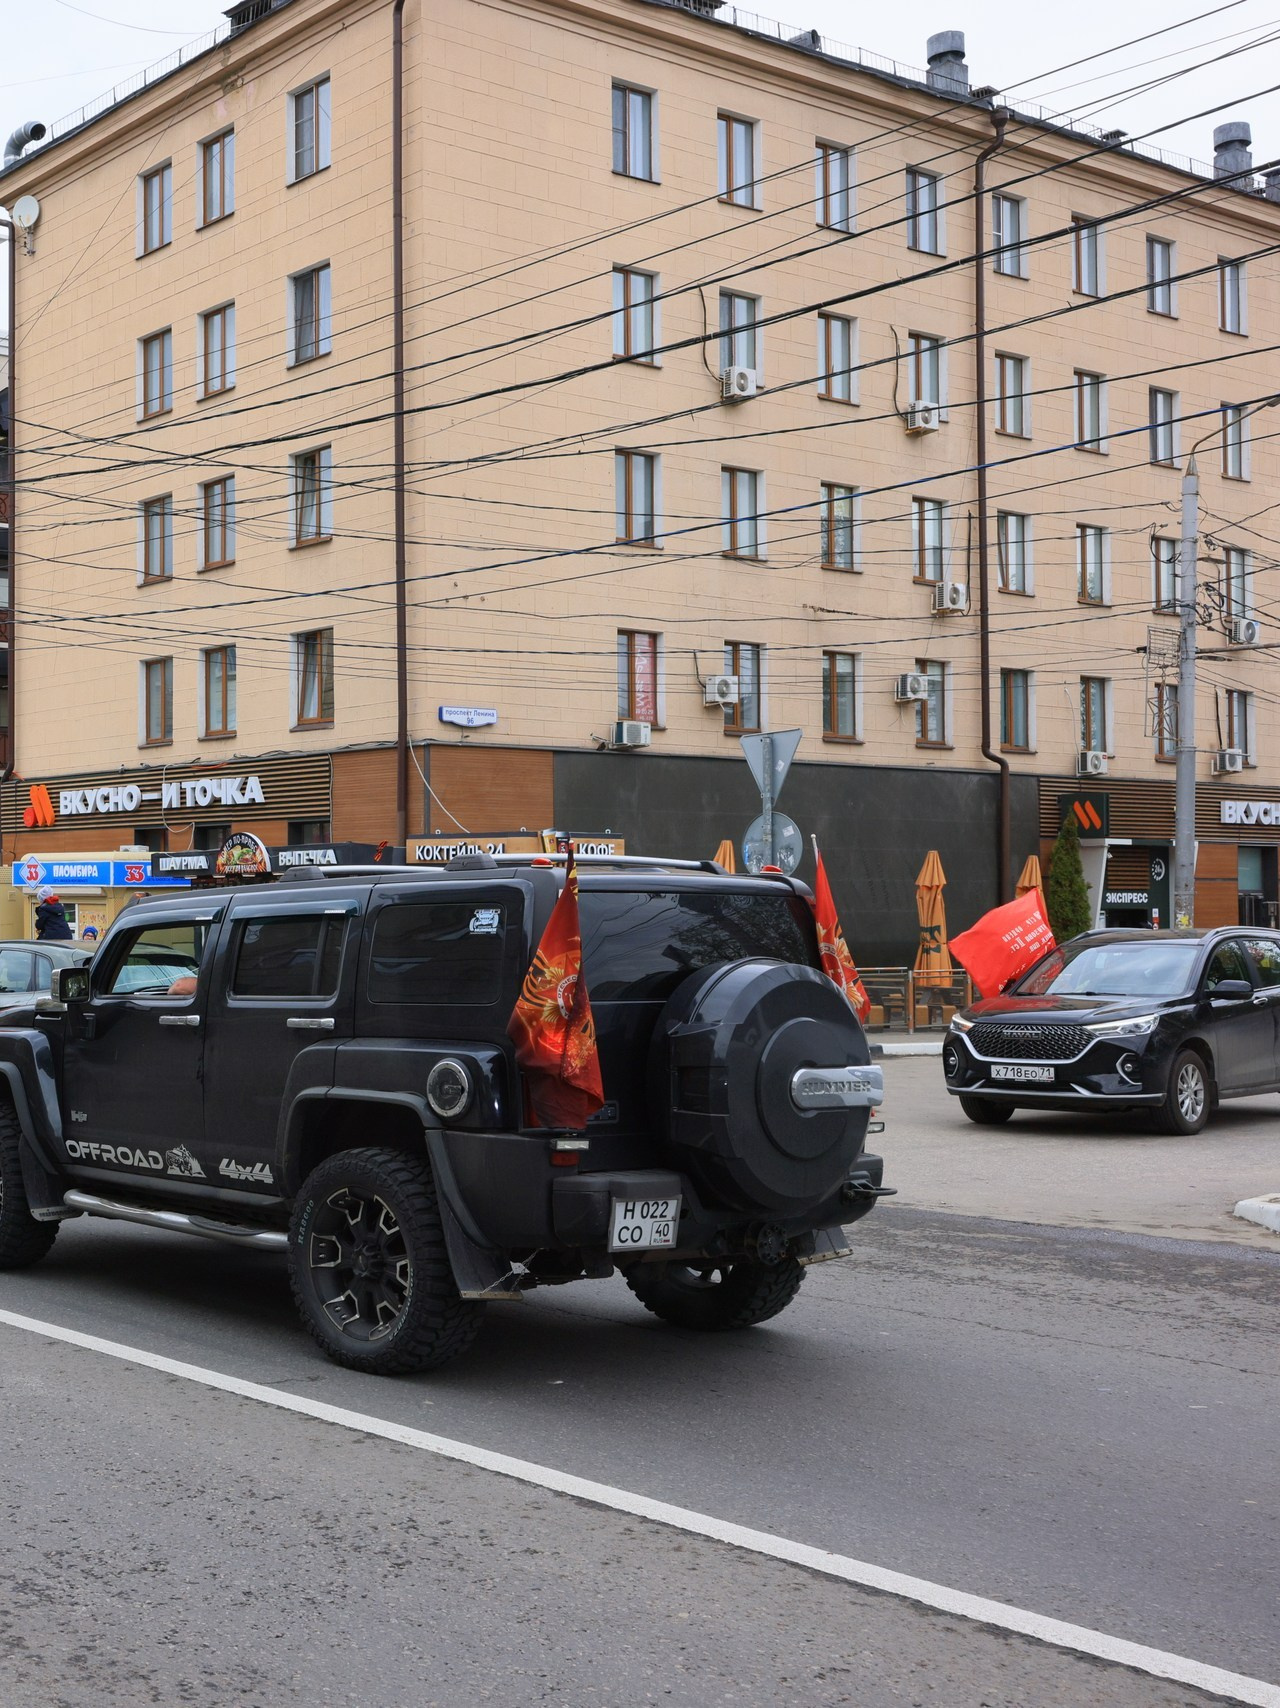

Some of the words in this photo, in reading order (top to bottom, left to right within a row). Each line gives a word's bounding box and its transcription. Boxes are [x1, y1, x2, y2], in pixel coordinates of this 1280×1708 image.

[445, 709, 473, 717] проспект
[473, 709, 495, 718] Ленина
[59, 784, 141, 815] ВКУСНО
[182, 776, 266, 807] ТОЧКА
[486, 843, 505, 854] 24
[579, 843, 615, 854] КОФЕ
[159, 855, 209, 871] ШАУРМА
[278, 849, 337, 866] ВЫПЕЧКА
[26, 864, 39, 881] 33
[53, 865, 99, 878] ПЛОМБИРА
[125, 865, 144, 882] 33
[1105, 891, 1149, 904] ЭКСПРЕСС
[995, 1067, 1038, 1078] Х718ЕО
[1040, 1067, 1051, 1077] 71
[801, 1080, 872, 1096] HUMMER
[65, 1139, 164, 1170] OFFROAD
[623, 1201, 636, 1220] Н
[640, 1200, 669, 1219] 022
[617, 1225, 643, 1244] СО
[655, 1223, 670, 1237] 40
